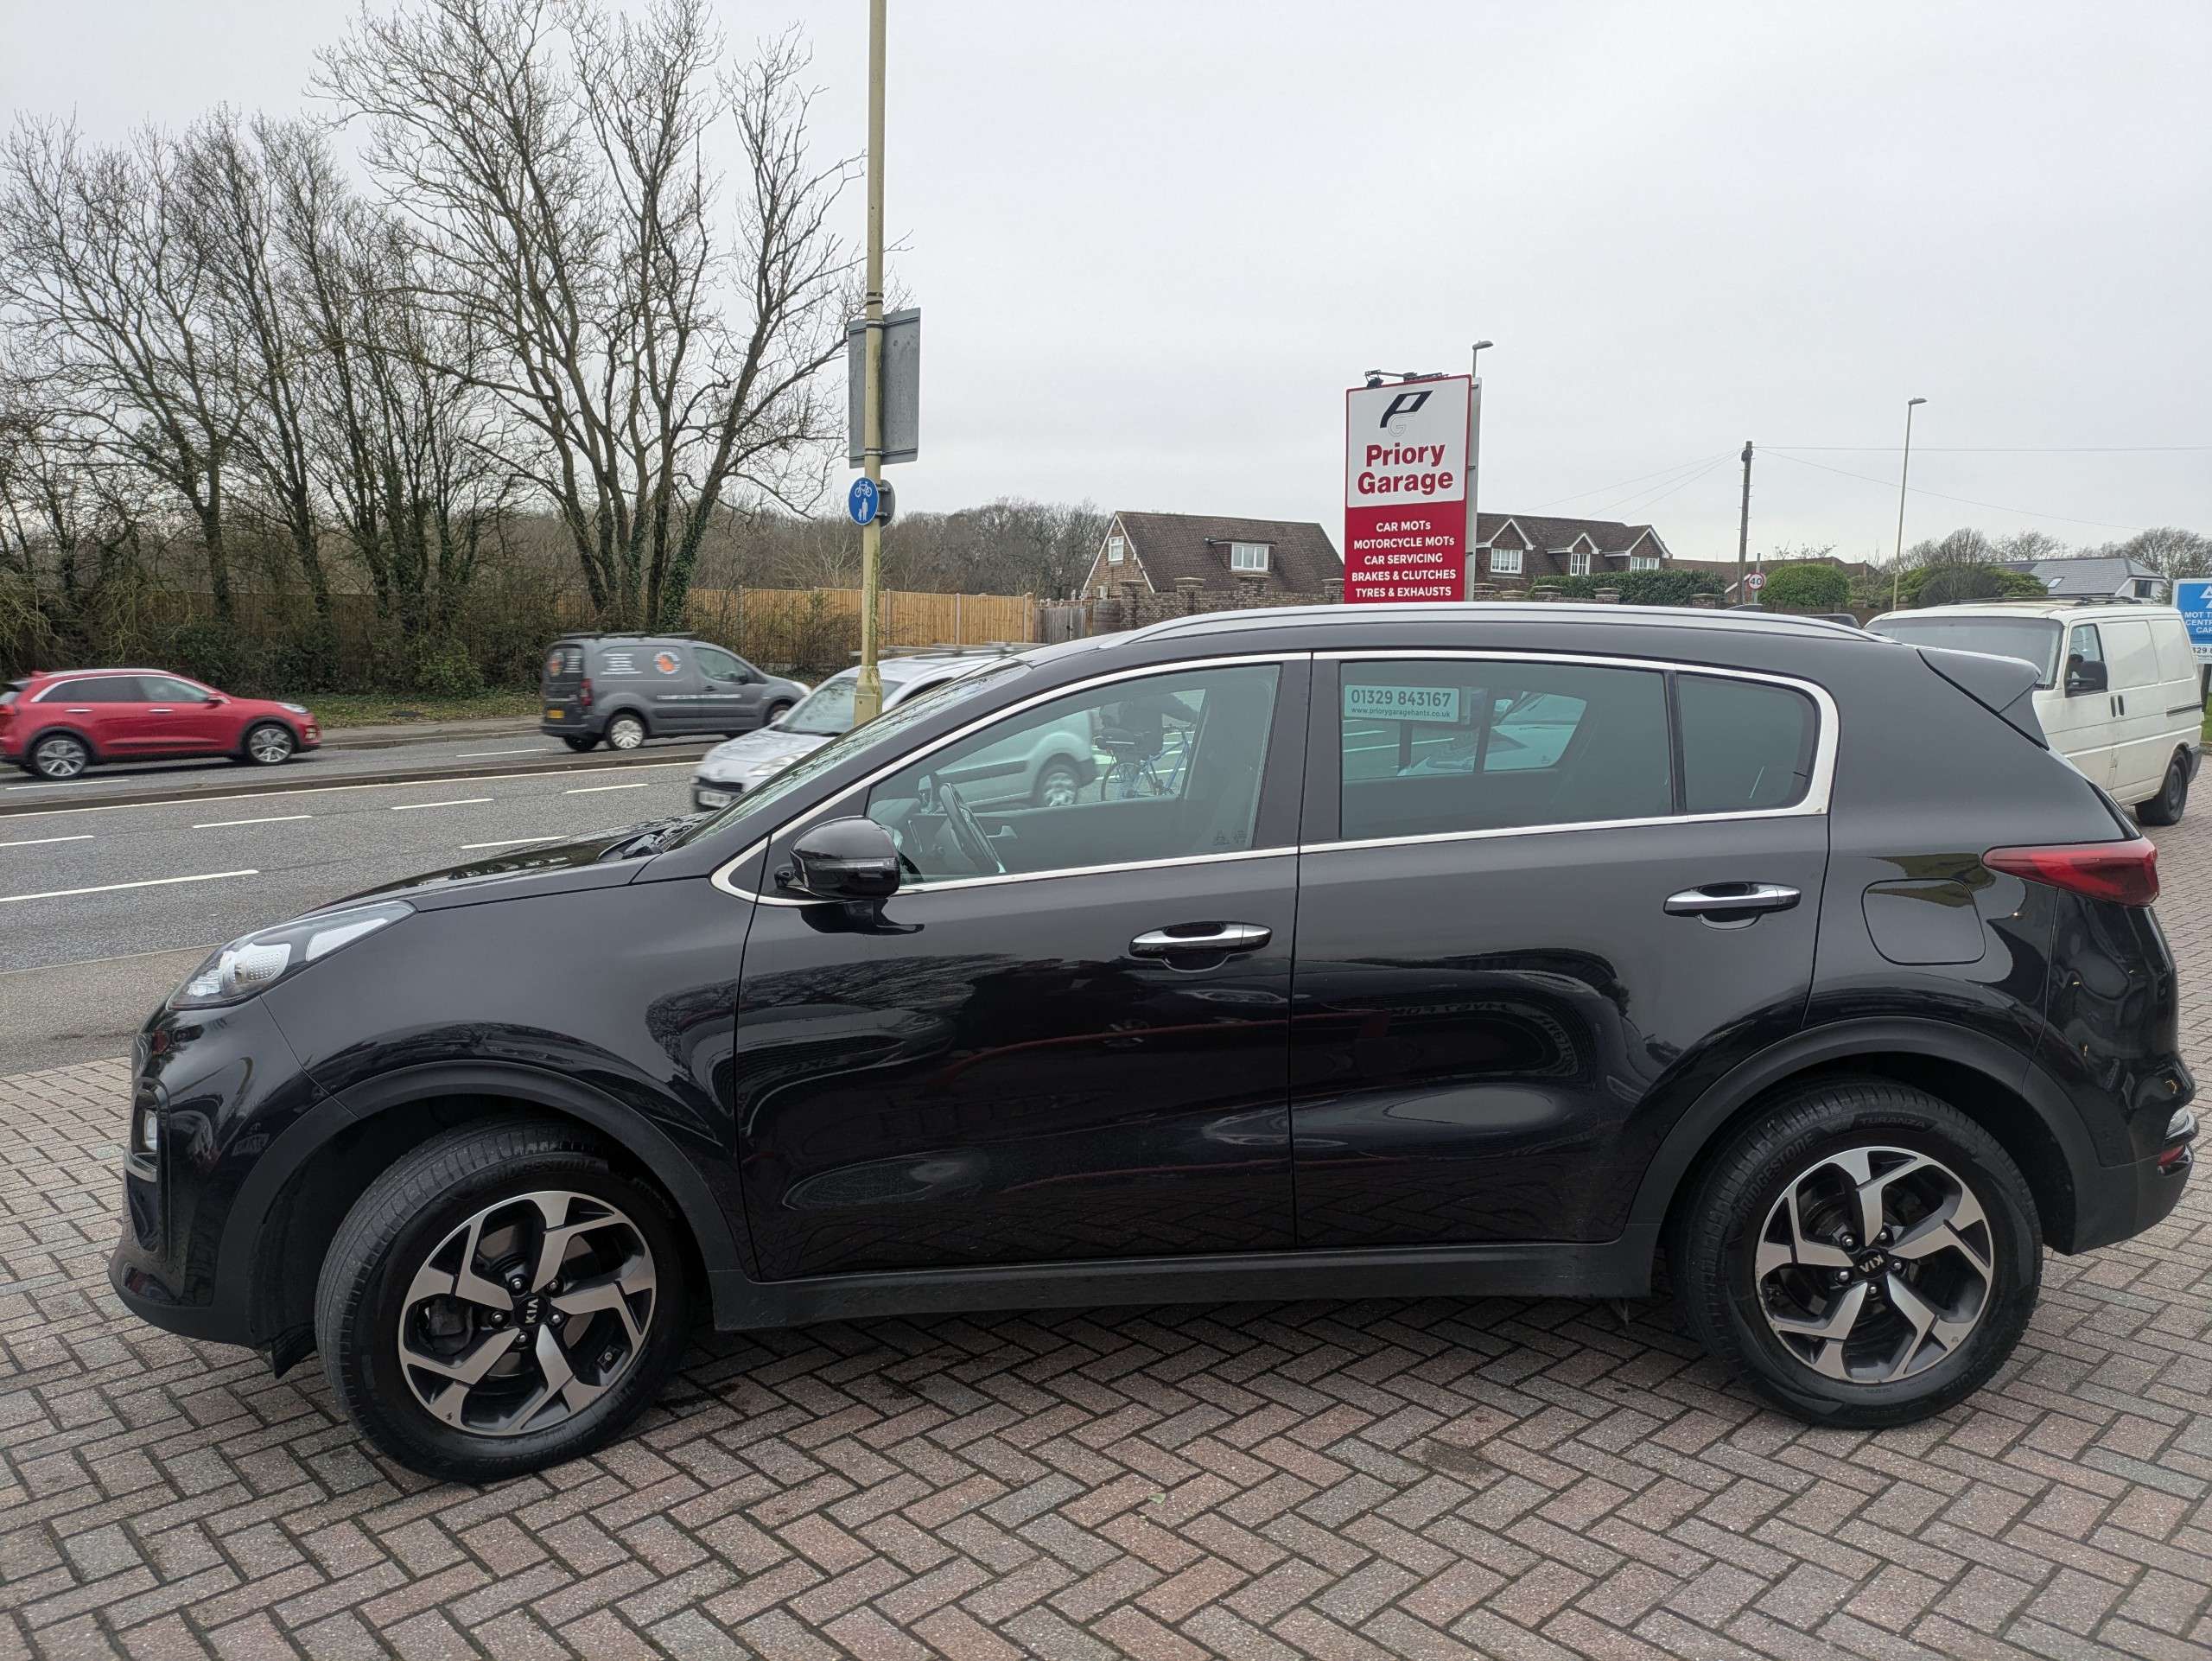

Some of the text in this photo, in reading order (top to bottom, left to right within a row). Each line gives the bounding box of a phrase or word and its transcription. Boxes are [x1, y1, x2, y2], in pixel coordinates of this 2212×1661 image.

[1366, 442, 1446, 468] Priory
[1357, 472, 1453, 496] Garage
[1376, 519, 1432, 532] CAR MOTs
[1353, 535, 1455, 550] MOTORCYCLE MOTs
[1363, 552, 1444, 565] CAR SERVICING
[1351, 569, 1457, 582] BRAKES & CLUTCHES
[1355, 585, 1452, 598] TYRES & EXHAUSTS
[1351, 689, 1452, 707] 01329 843167
[1351, 707, 1451, 717] www.priorygaragehants.co.uk
[1859, 1254, 1885, 1273] KIA
[524, 1298, 540, 1324] KIA
